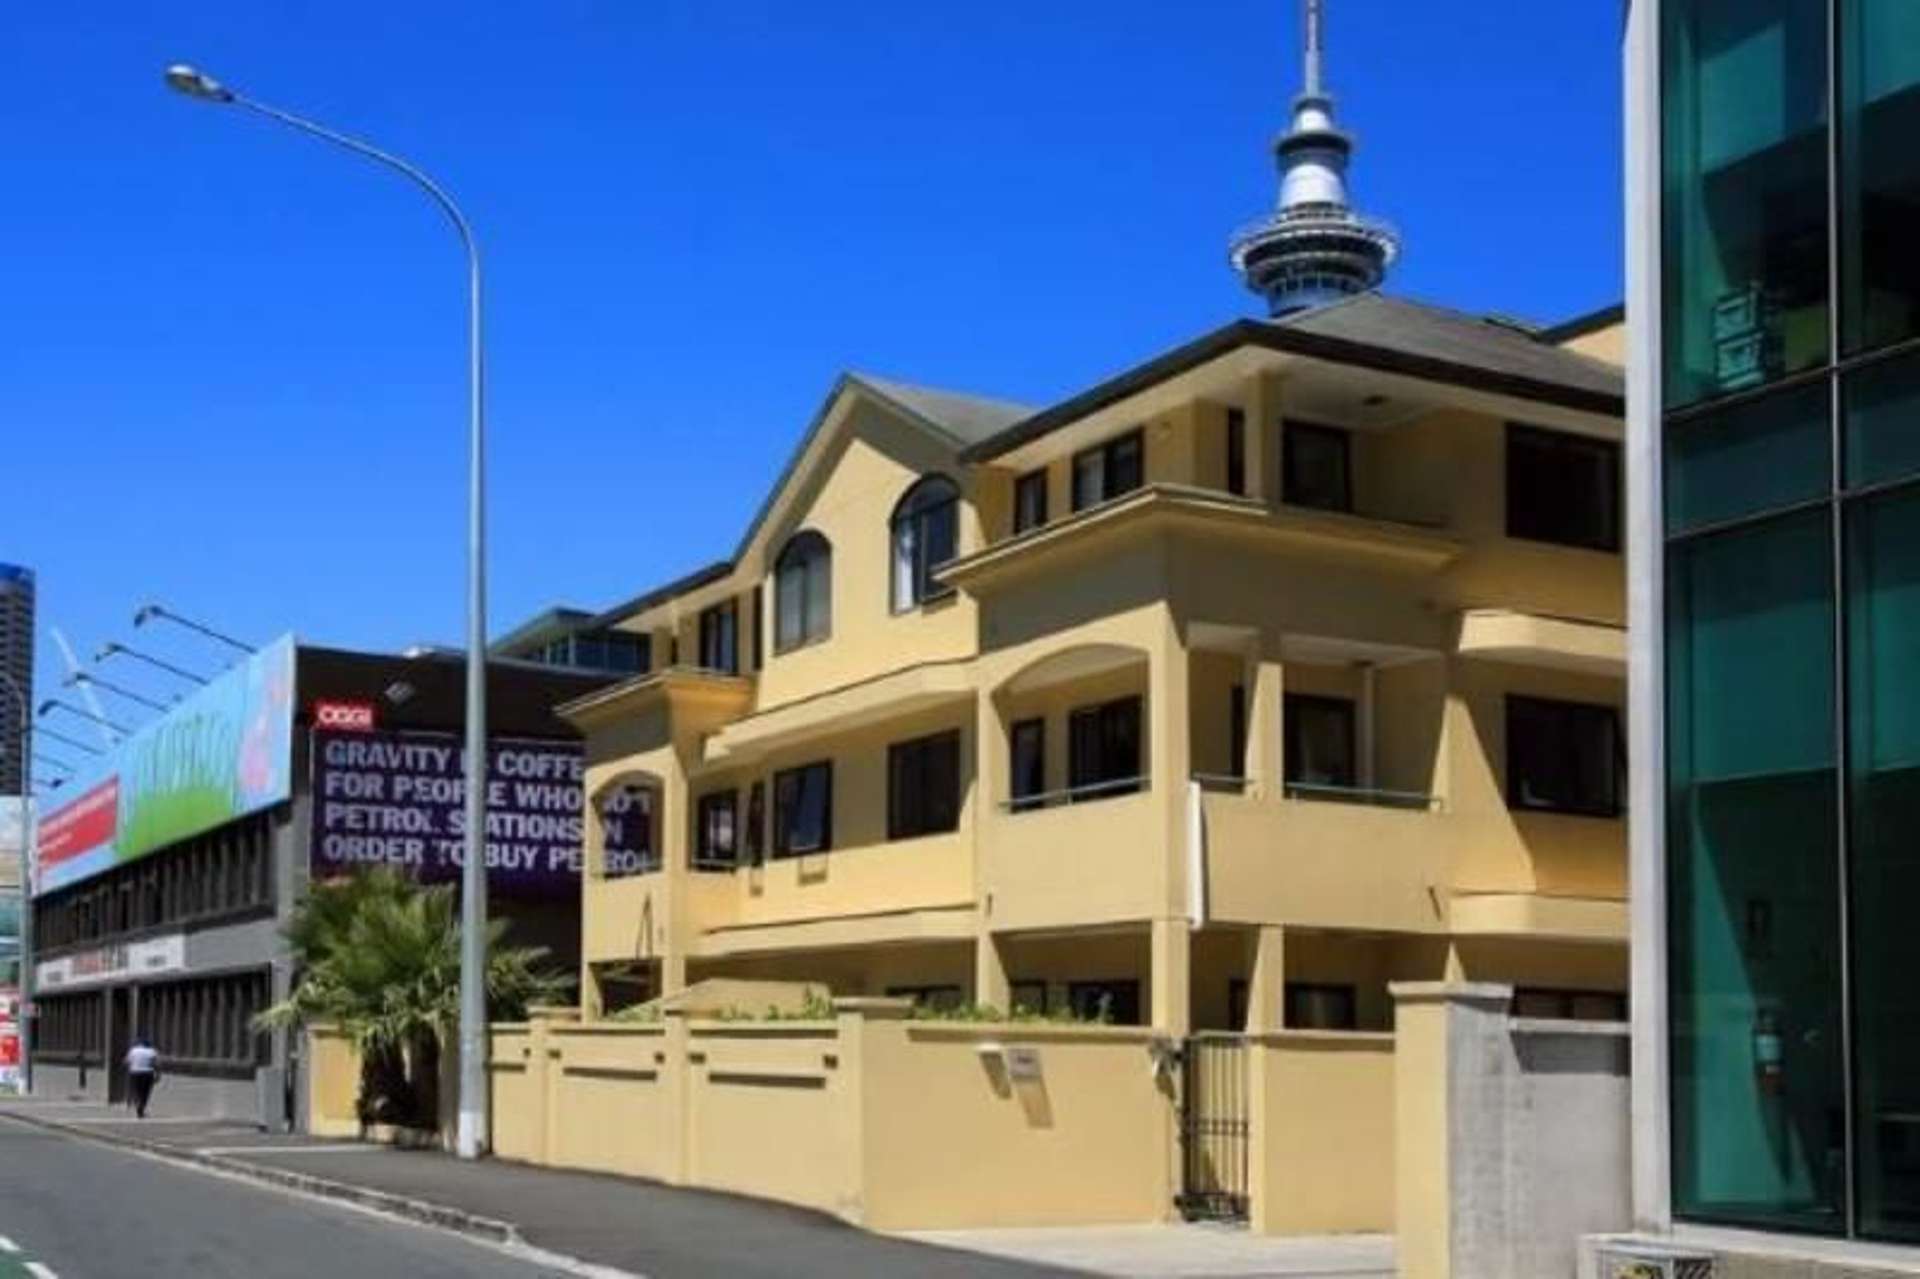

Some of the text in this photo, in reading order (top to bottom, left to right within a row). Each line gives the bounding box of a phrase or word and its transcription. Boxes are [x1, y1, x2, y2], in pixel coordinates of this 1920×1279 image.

[325, 739, 452, 773] GRAVITY
[498, 750, 585, 780] COFFE
[325, 771, 385, 799] FOR
[392, 774, 507, 807] PEOPE
[515, 782, 584, 811] WHO
[325, 800, 442, 834] PETROL
[447, 808, 585, 842] SATIONS
[322, 834, 424, 864] ORDER
[431, 839, 467, 867] TO
[484, 842, 539, 870] BUY
